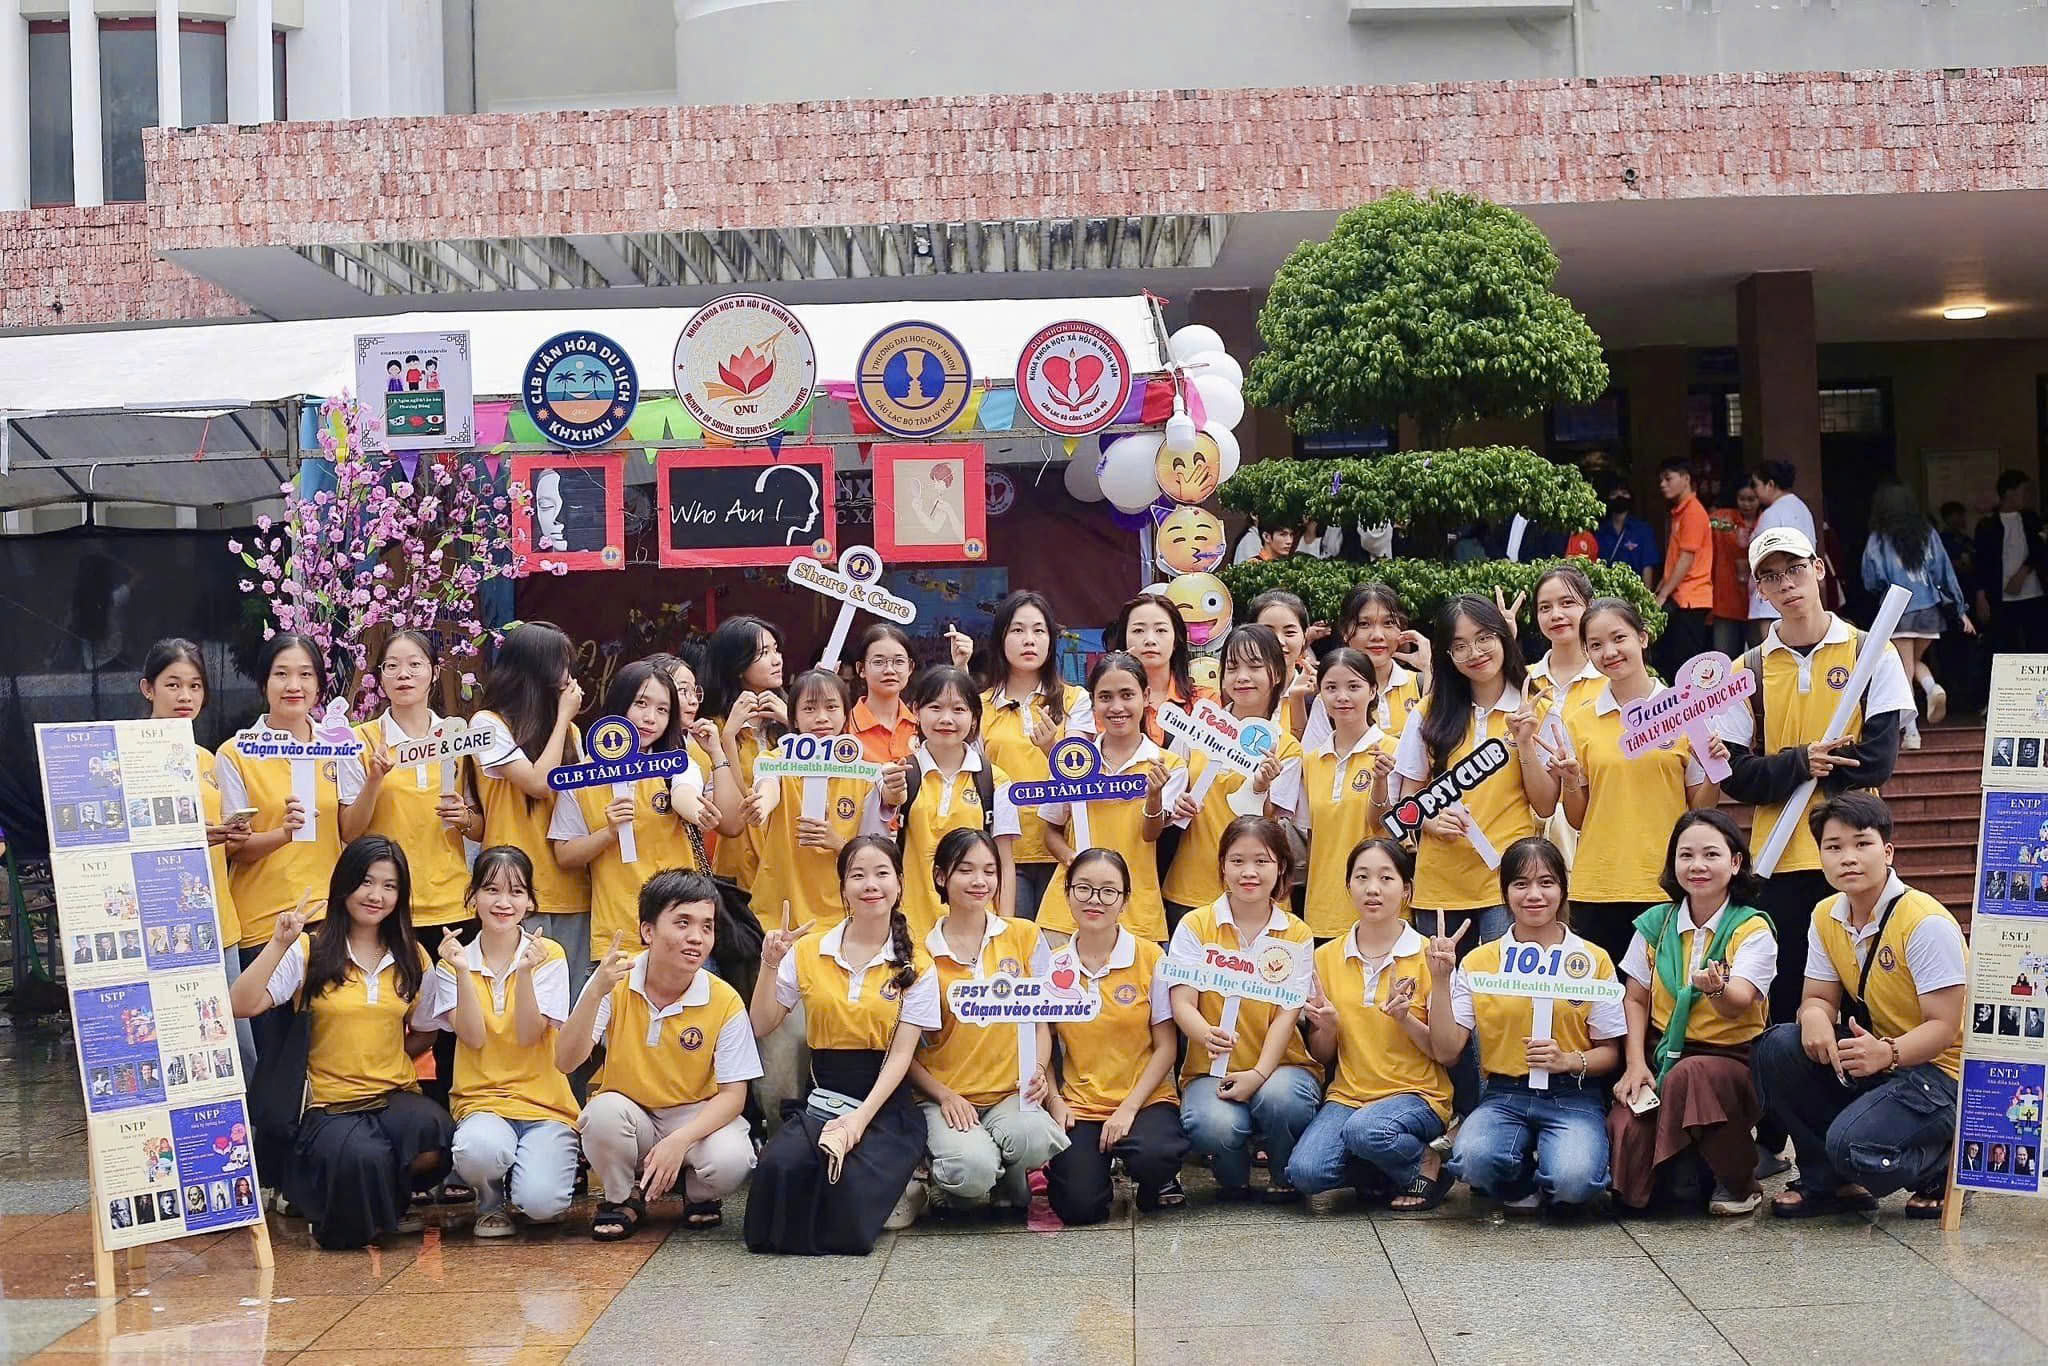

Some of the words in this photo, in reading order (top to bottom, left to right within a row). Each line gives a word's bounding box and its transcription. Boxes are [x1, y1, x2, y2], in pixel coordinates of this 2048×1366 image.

[564, 336, 597, 352] HÓA
[926, 339, 943, 350] QUY
[1070, 325, 1114, 346] UNIVERSITY
[535, 346, 563, 373] VĂN
[599, 347, 620, 366] DU
[1029, 360, 1039, 380] KHOA
[1035, 344, 1051, 361] KHOA
[531, 377, 542, 404] CLB
[615, 367, 630, 402] LỊCH
[734, 405, 758, 415] QNU
[549, 419, 613, 441] KHXHNV
[704, 414, 713, 423] OF
[711, 419, 734, 434] SOCIAL
[736, 424, 768, 435] SCIENCES
[671, 500, 717, 526] Who
[725, 499, 764, 523] Am
[775, 499, 783, 521] I
[795, 563, 847, 593] Share
[849, 584, 864, 601] &
[868, 592, 910, 618] Care
[1626, 732, 1648, 752] TÂM
[1650, 722, 1660, 740] LÝ
[1662, 713, 1682, 732] HỌC
[1684, 699, 1706, 721] GIÁO
[1707, 688, 1727, 708] DỤC
[1728, 677, 1748, 696] K47
[1628, 694, 1679, 727] Team
[1199, 706, 1238, 740] Team
[66, 733, 90, 742] ISTJ
[140, 728, 164, 738] ISFJ
[239, 733, 259, 741] #PSY
[1165, 710, 1187, 732] Tâm
[1189, 726, 1204, 741] Lý
[1204, 735, 1226, 752] Học
[1227, 748, 1251, 769] Giáo
[281, 743, 304, 755] vào
[306, 743, 332, 755] cảm
[400, 744, 436, 763] LOVE
[440, 741, 449, 753] &
[454, 732, 491, 751] CARE
[554, 771, 584, 784] CLB
[586, 765, 621, 780] TÂM
[625, 759, 645, 775] LÝ
[648, 757, 682, 772] HỌC
[760, 762, 789, 772] World
[790, 762, 822, 772] Health
[824, 764, 856, 773] Mental
[858, 766, 877, 776] Day
[1015, 787, 1045, 799] CLB
[1048, 783, 1081, 796] TÂM
[1083, 780, 1105, 794] LÝ
[1109, 780, 1143, 794] HỌC
[1385, 816, 1404, 838] I
[1418, 776, 1458, 815] PSY
[1456, 743, 1504, 786] CLUB
[2010, 799, 2041, 808] ENTP
[82, 863, 108, 872] INTJ
[156, 855, 182, 865] INFJ
[2002, 931, 2029, 941] ESTJ
[1206, 950, 1254, 974] Team
[175, 982, 199, 993] ISFP
[952, 985, 989, 997] #PSY
[1014, 984, 1040, 996] CLB
[1162, 963, 1190, 979] Tâm
[1194, 970, 1210, 986] Lý
[1214, 974, 1239, 991] Học
[1241, 980, 1271, 996] Giáo
[1275, 987, 1300, 1004] Dục
[1473, 976, 1510, 989] World
[1512, 980, 1550, 992] Health
[1554, 983, 1594, 995] Mental
[1597, 986, 1620, 997] Day
[100, 991, 125, 1002] ISTP
[1004, 1001, 1031, 1016] vào
[1033, 1000, 1063, 1016] cảm
[1989, 1068, 2019, 1079] ENTJ
[194, 1109, 220, 1121] INFP
[120, 1121, 146, 1133] INTP
